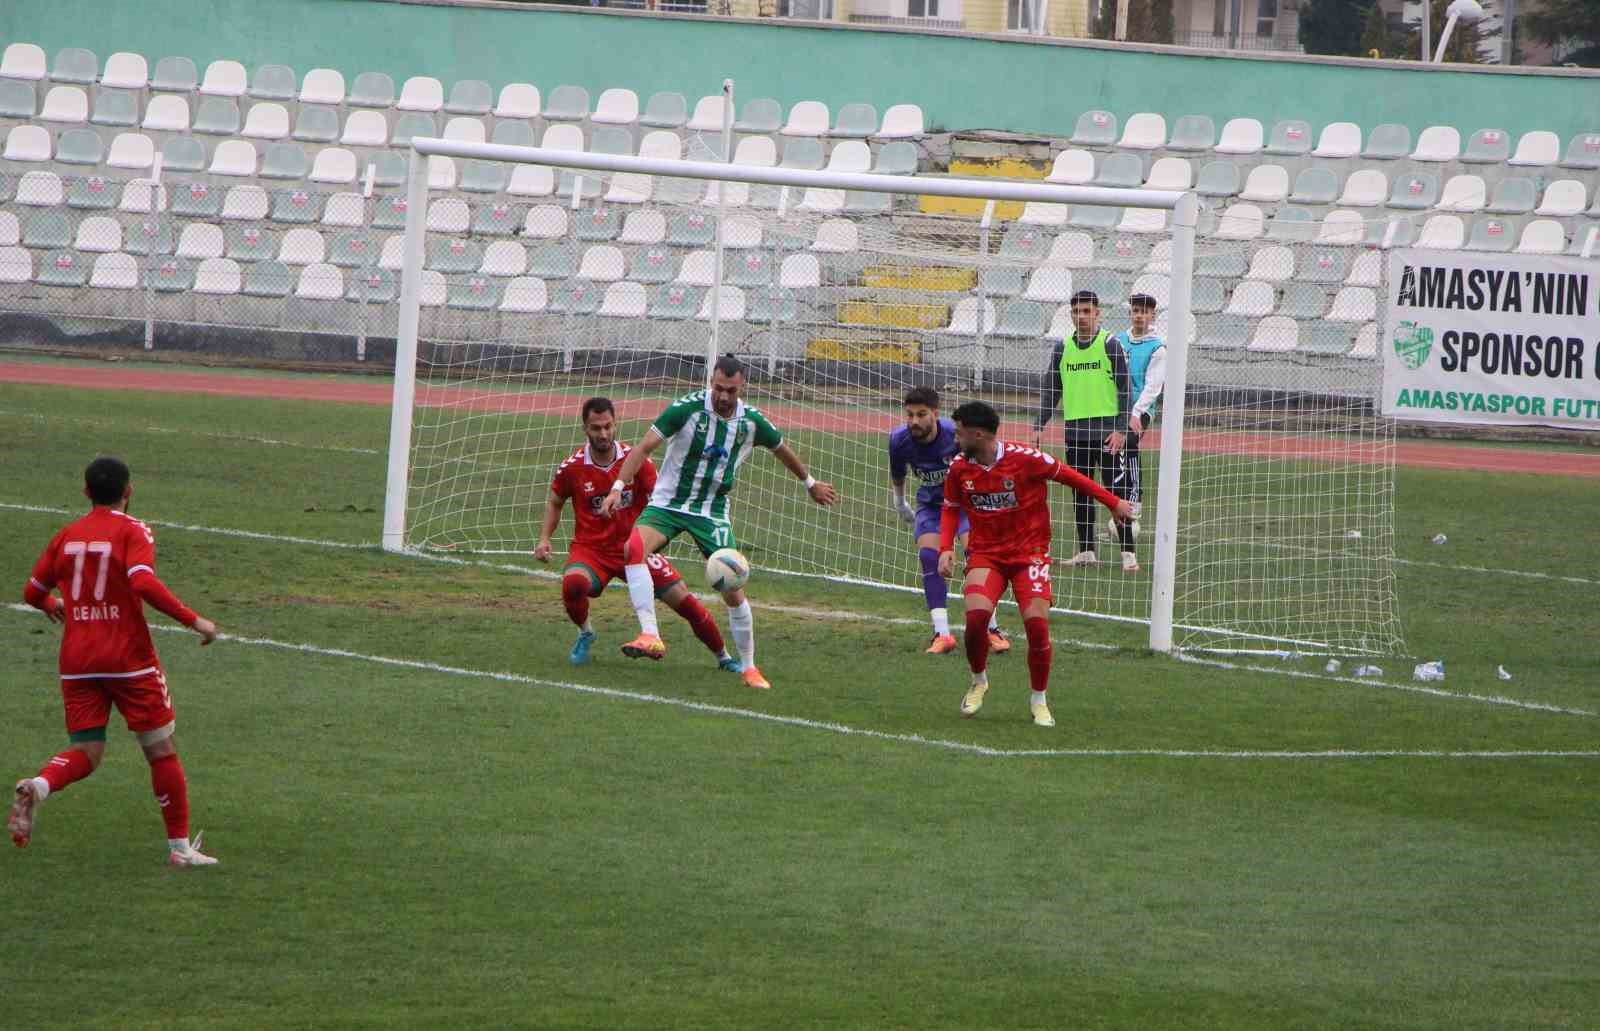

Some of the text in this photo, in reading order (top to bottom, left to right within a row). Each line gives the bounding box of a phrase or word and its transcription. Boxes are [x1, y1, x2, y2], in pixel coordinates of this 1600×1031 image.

[1398, 266, 1589, 316] AMASYA'NIN
[1066, 359, 1101, 372] hummel
[1442, 331, 1584, 379] SPONSOR
[1397, 389, 1600, 418] AMASYASPOR FUT
[711, 526, 729, 546] 17
[64, 541, 112, 601] 77
[1028, 563, 1050, 582] 64
[73, 602, 120, 621] DEMİR
